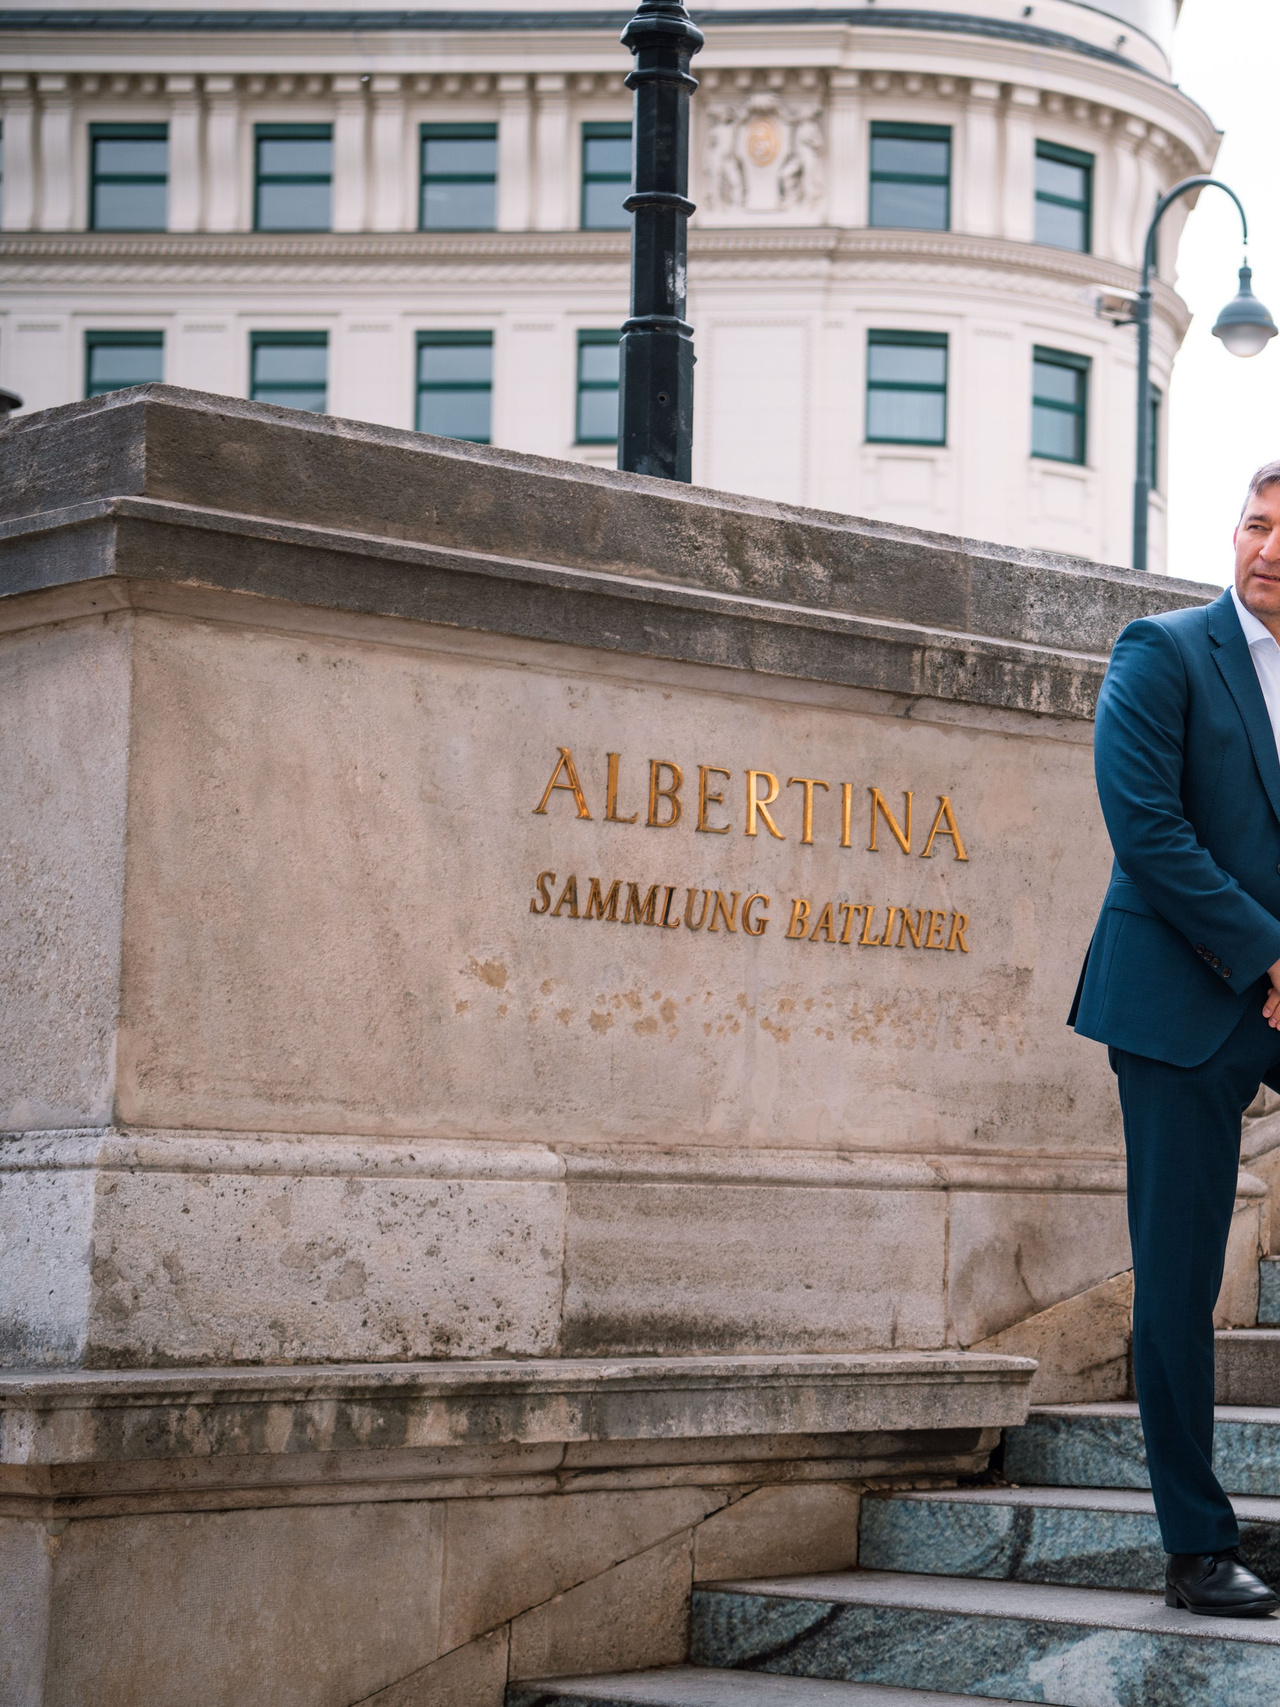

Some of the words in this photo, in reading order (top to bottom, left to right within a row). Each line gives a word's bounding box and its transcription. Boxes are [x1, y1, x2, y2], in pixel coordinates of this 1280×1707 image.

[532, 747, 969, 861] ALBERTINA
[530, 870, 770, 935] SAMMLUNG
[786, 898, 970, 953] BATLINER
